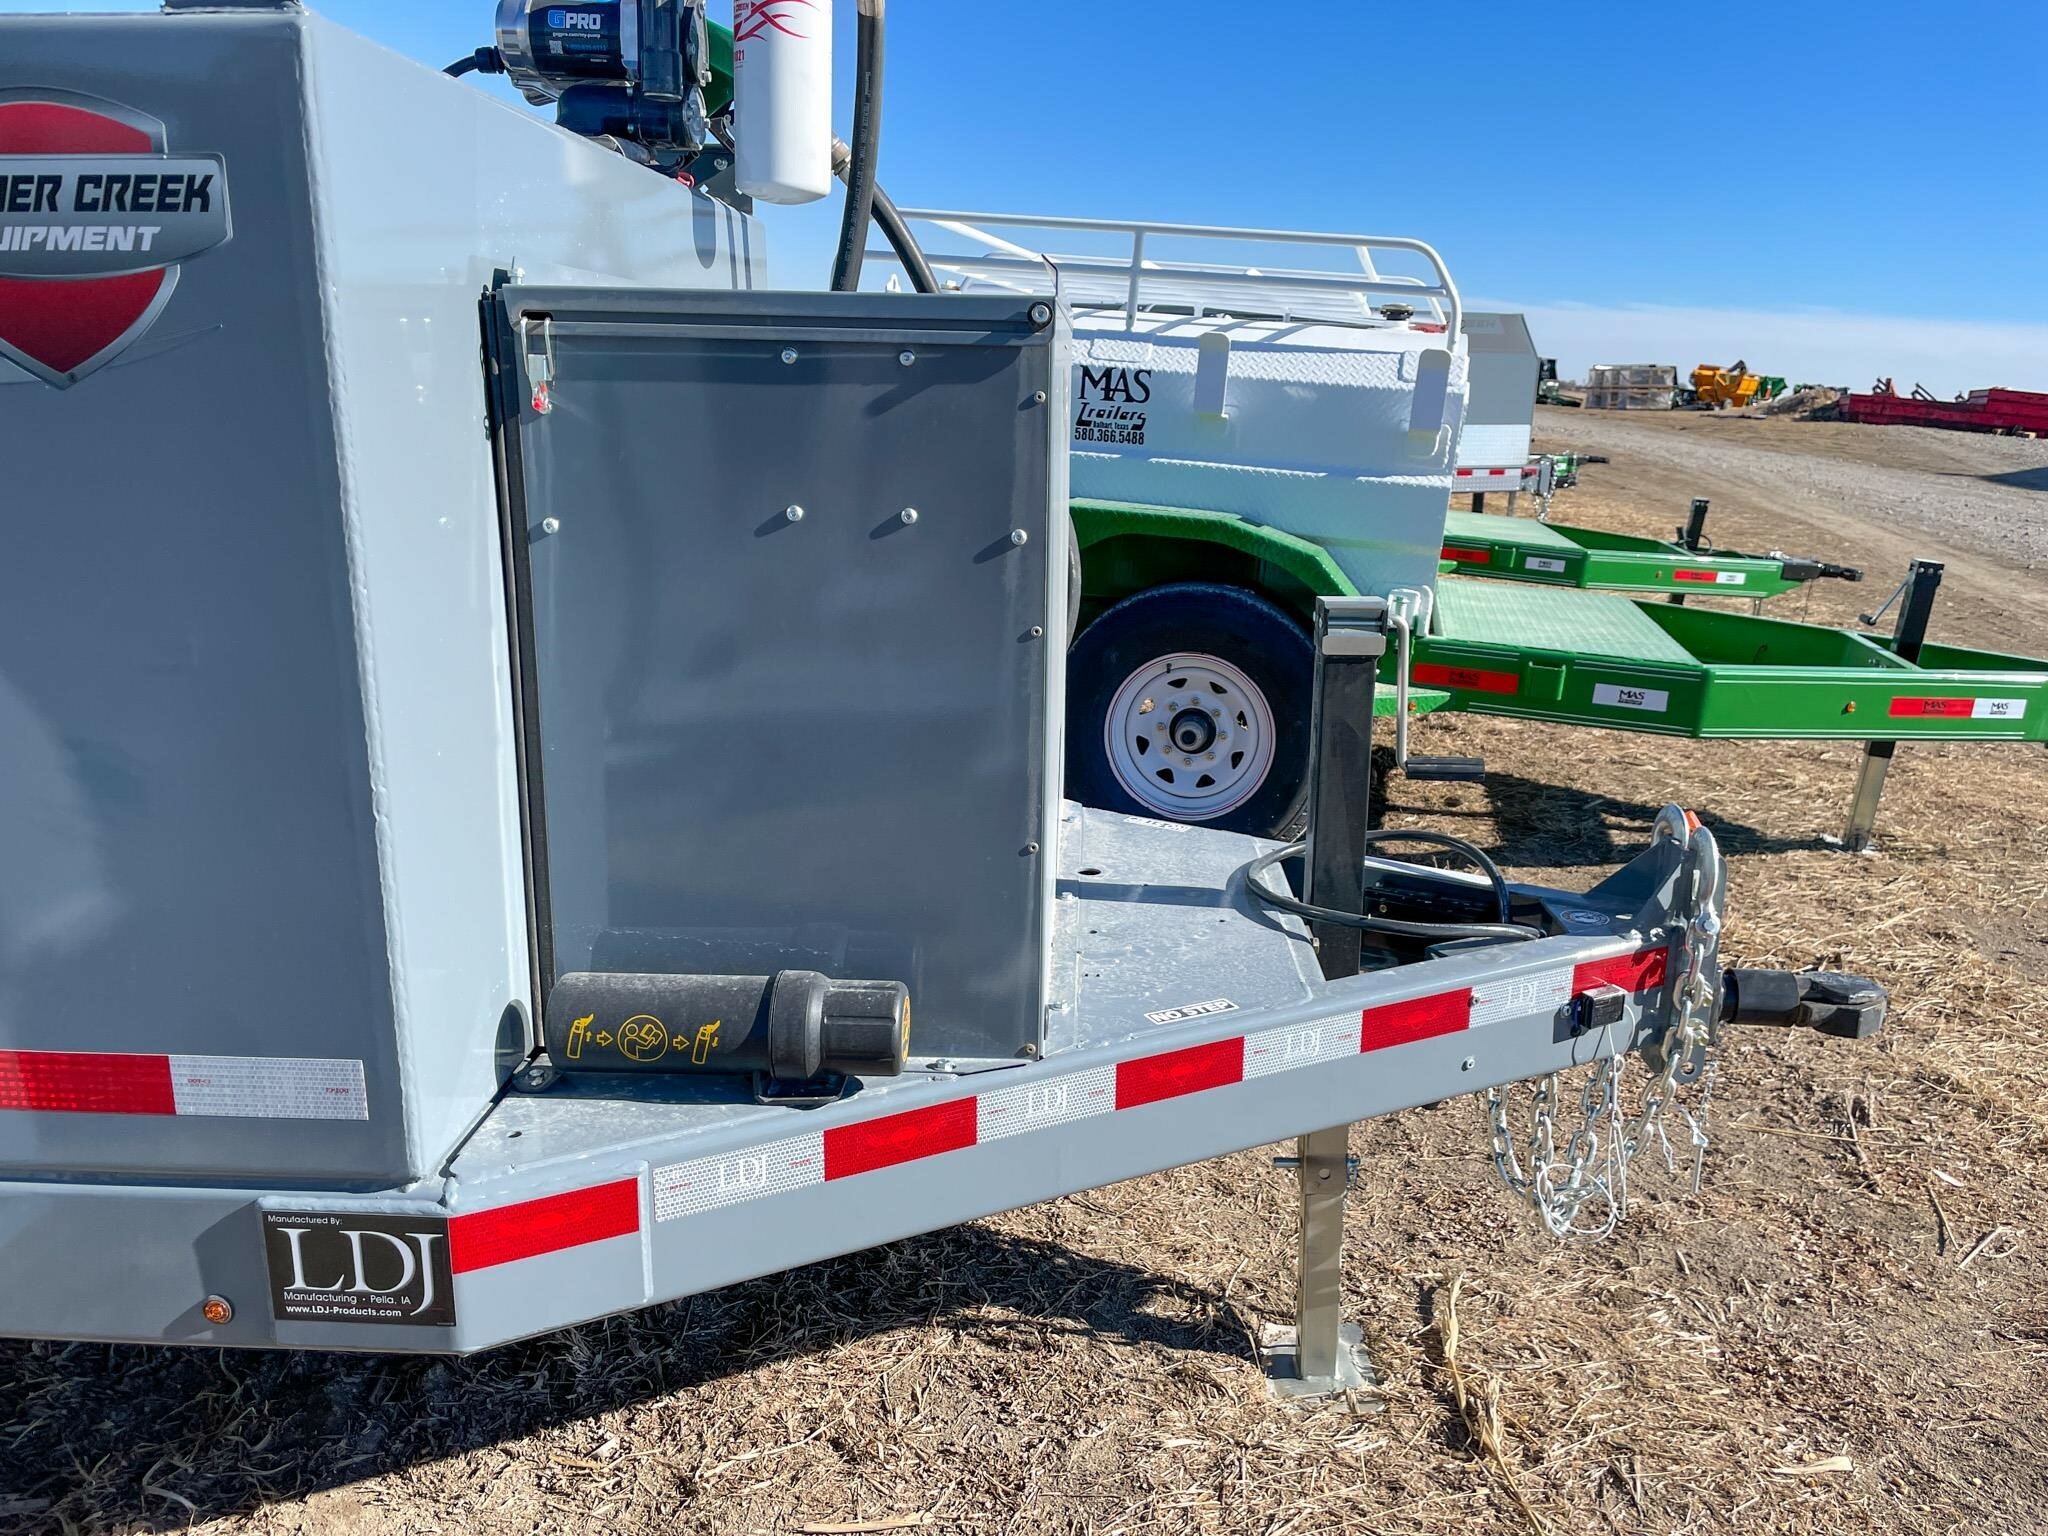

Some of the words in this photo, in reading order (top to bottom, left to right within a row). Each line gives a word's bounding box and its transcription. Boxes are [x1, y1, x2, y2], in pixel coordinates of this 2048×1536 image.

[548, 10, 601, 29] GPRO
[74, 175, 214, 213] CREEK
[1077, 365, 1152, 404] MAS
[1076, 402, 1147, 431] Trailers
[1075, 428, 1145, 445] 580.366.5488
[1619, 689, 1645, 700] MAS
[1923, 701, 1947, 709] MAS
[1991, 702, 2010, 710] MAS
[1150, 1010, 1182, 1022] NO
[1181, 1001, 1229, 1016] STEP
[267, 1215, 328, 1225] Manufactured
[330, 1217, 343, 1226] By:
[277, 1228, 443, 1316] LDJ
[284, 1291, 357, 1305] Manufacturing
[370, 1294, 397, 1305] Pella,
[400, 1296, 411, 1305] IA
[286, 1305, 402, 1317] www.LDJ-Products.com
